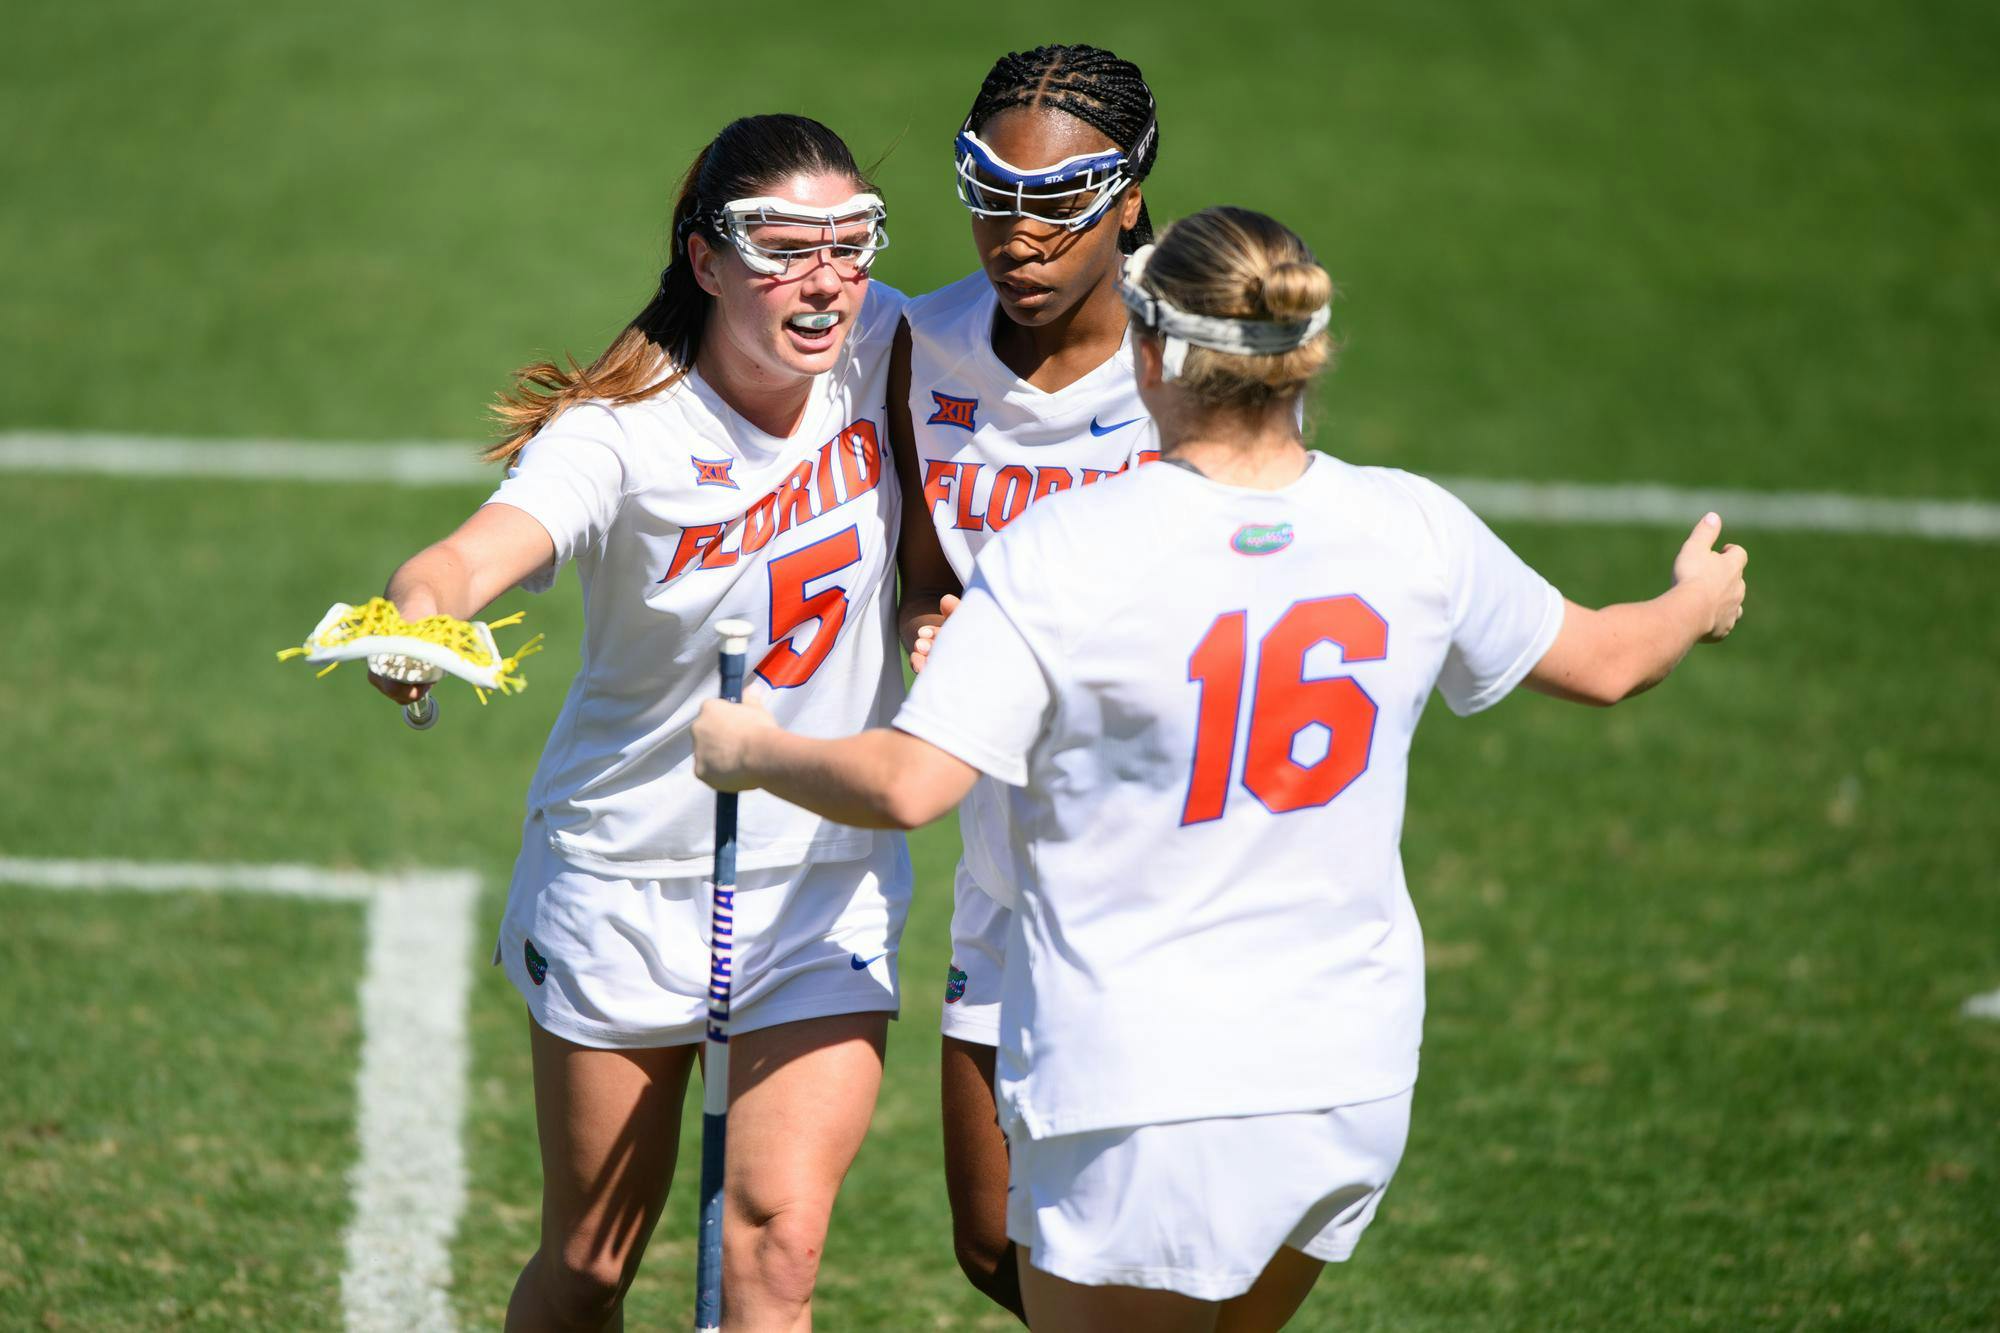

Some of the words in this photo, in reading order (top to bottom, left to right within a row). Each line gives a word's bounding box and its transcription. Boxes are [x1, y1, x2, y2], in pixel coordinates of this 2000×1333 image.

[1045, 175, 1064, 185] STX
[656, 417, 886, 584] FLORID
[753, 523, 861, 690] 5
[1179, 593, 1388, 827] 16
